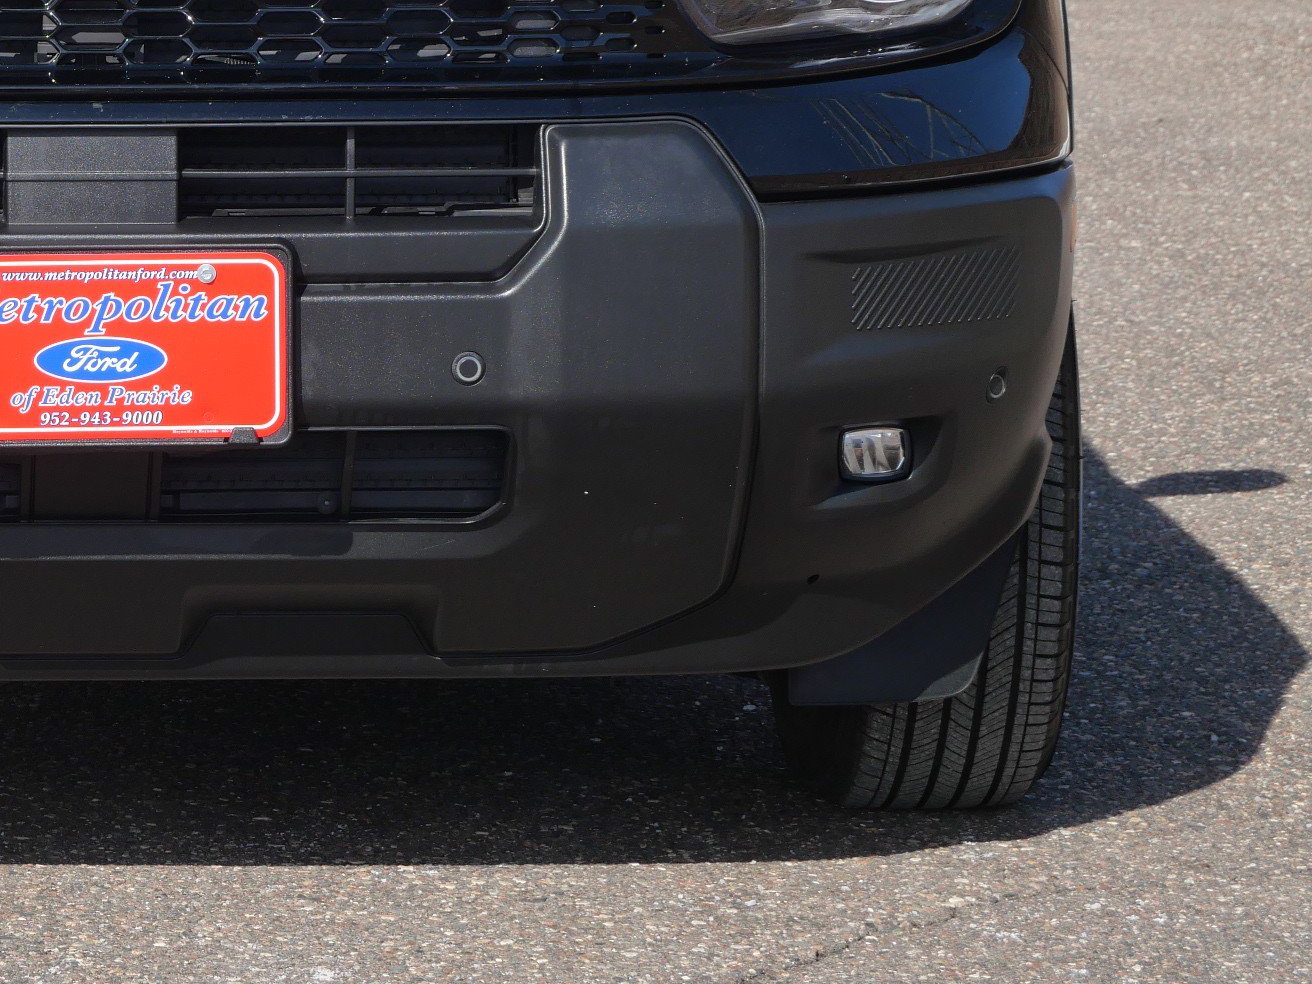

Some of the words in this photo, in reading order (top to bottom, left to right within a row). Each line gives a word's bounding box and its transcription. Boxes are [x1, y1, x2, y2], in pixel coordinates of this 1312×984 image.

[1, 268, 198, 283] www.metropolitanford.com
[62, 344, 139, 372] Ford
[10, 385, 40, 414] of
[39, 385, 101, 407] Eden
[105, 384, 193, 407] Prairie
[40, 410, 163, 427] 952-943-9000
